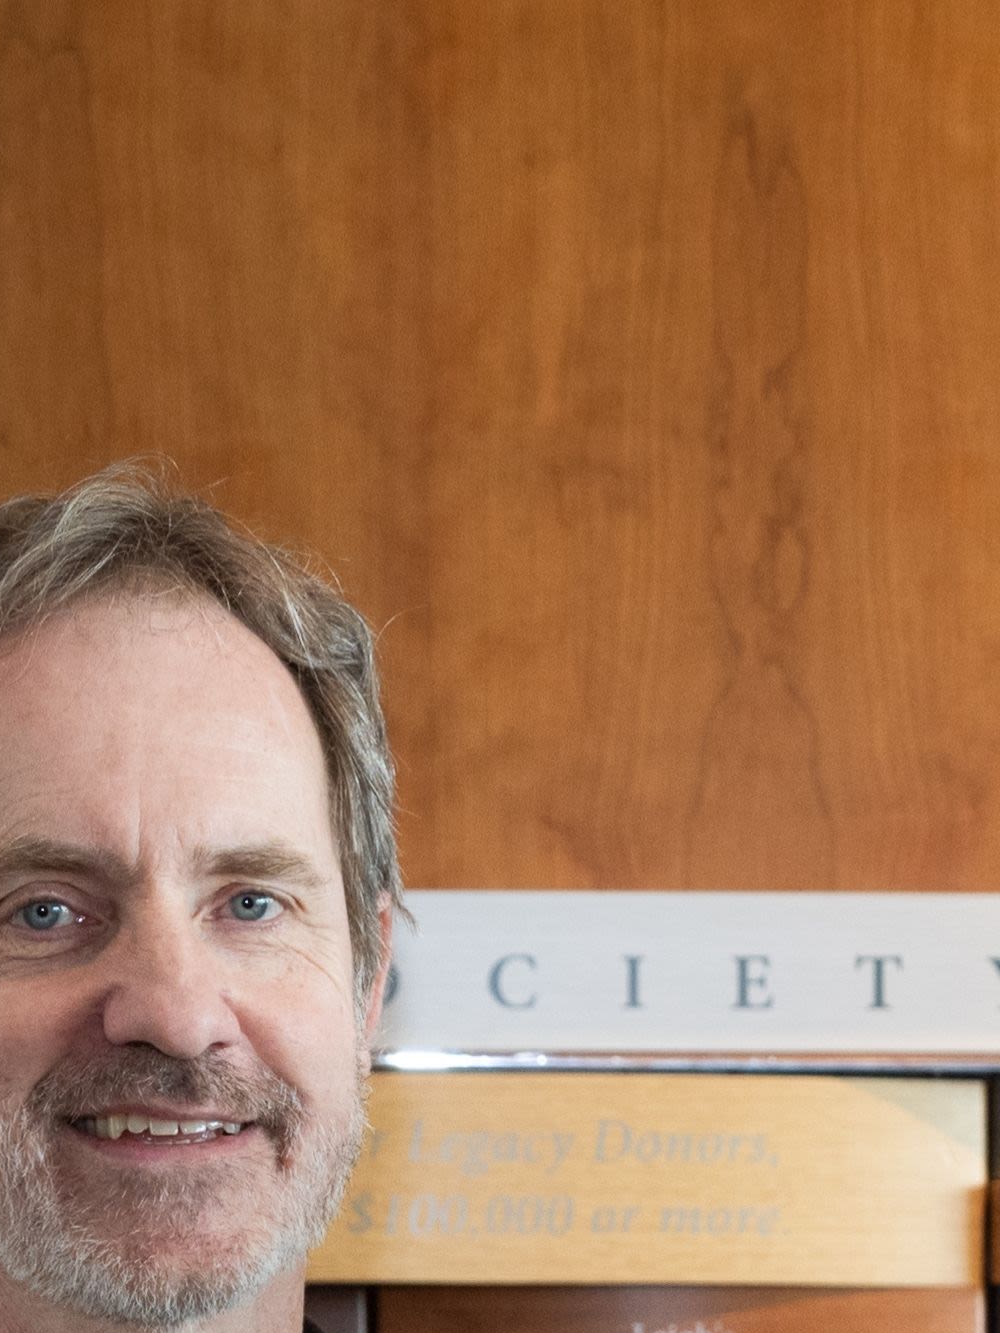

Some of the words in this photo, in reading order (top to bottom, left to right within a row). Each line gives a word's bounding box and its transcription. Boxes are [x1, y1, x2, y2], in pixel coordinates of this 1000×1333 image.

[383, 952, 1000, 1010] CIET
[406, 1118, 575, 1178] Legacy
[590, 1206, 642, 1236] or
